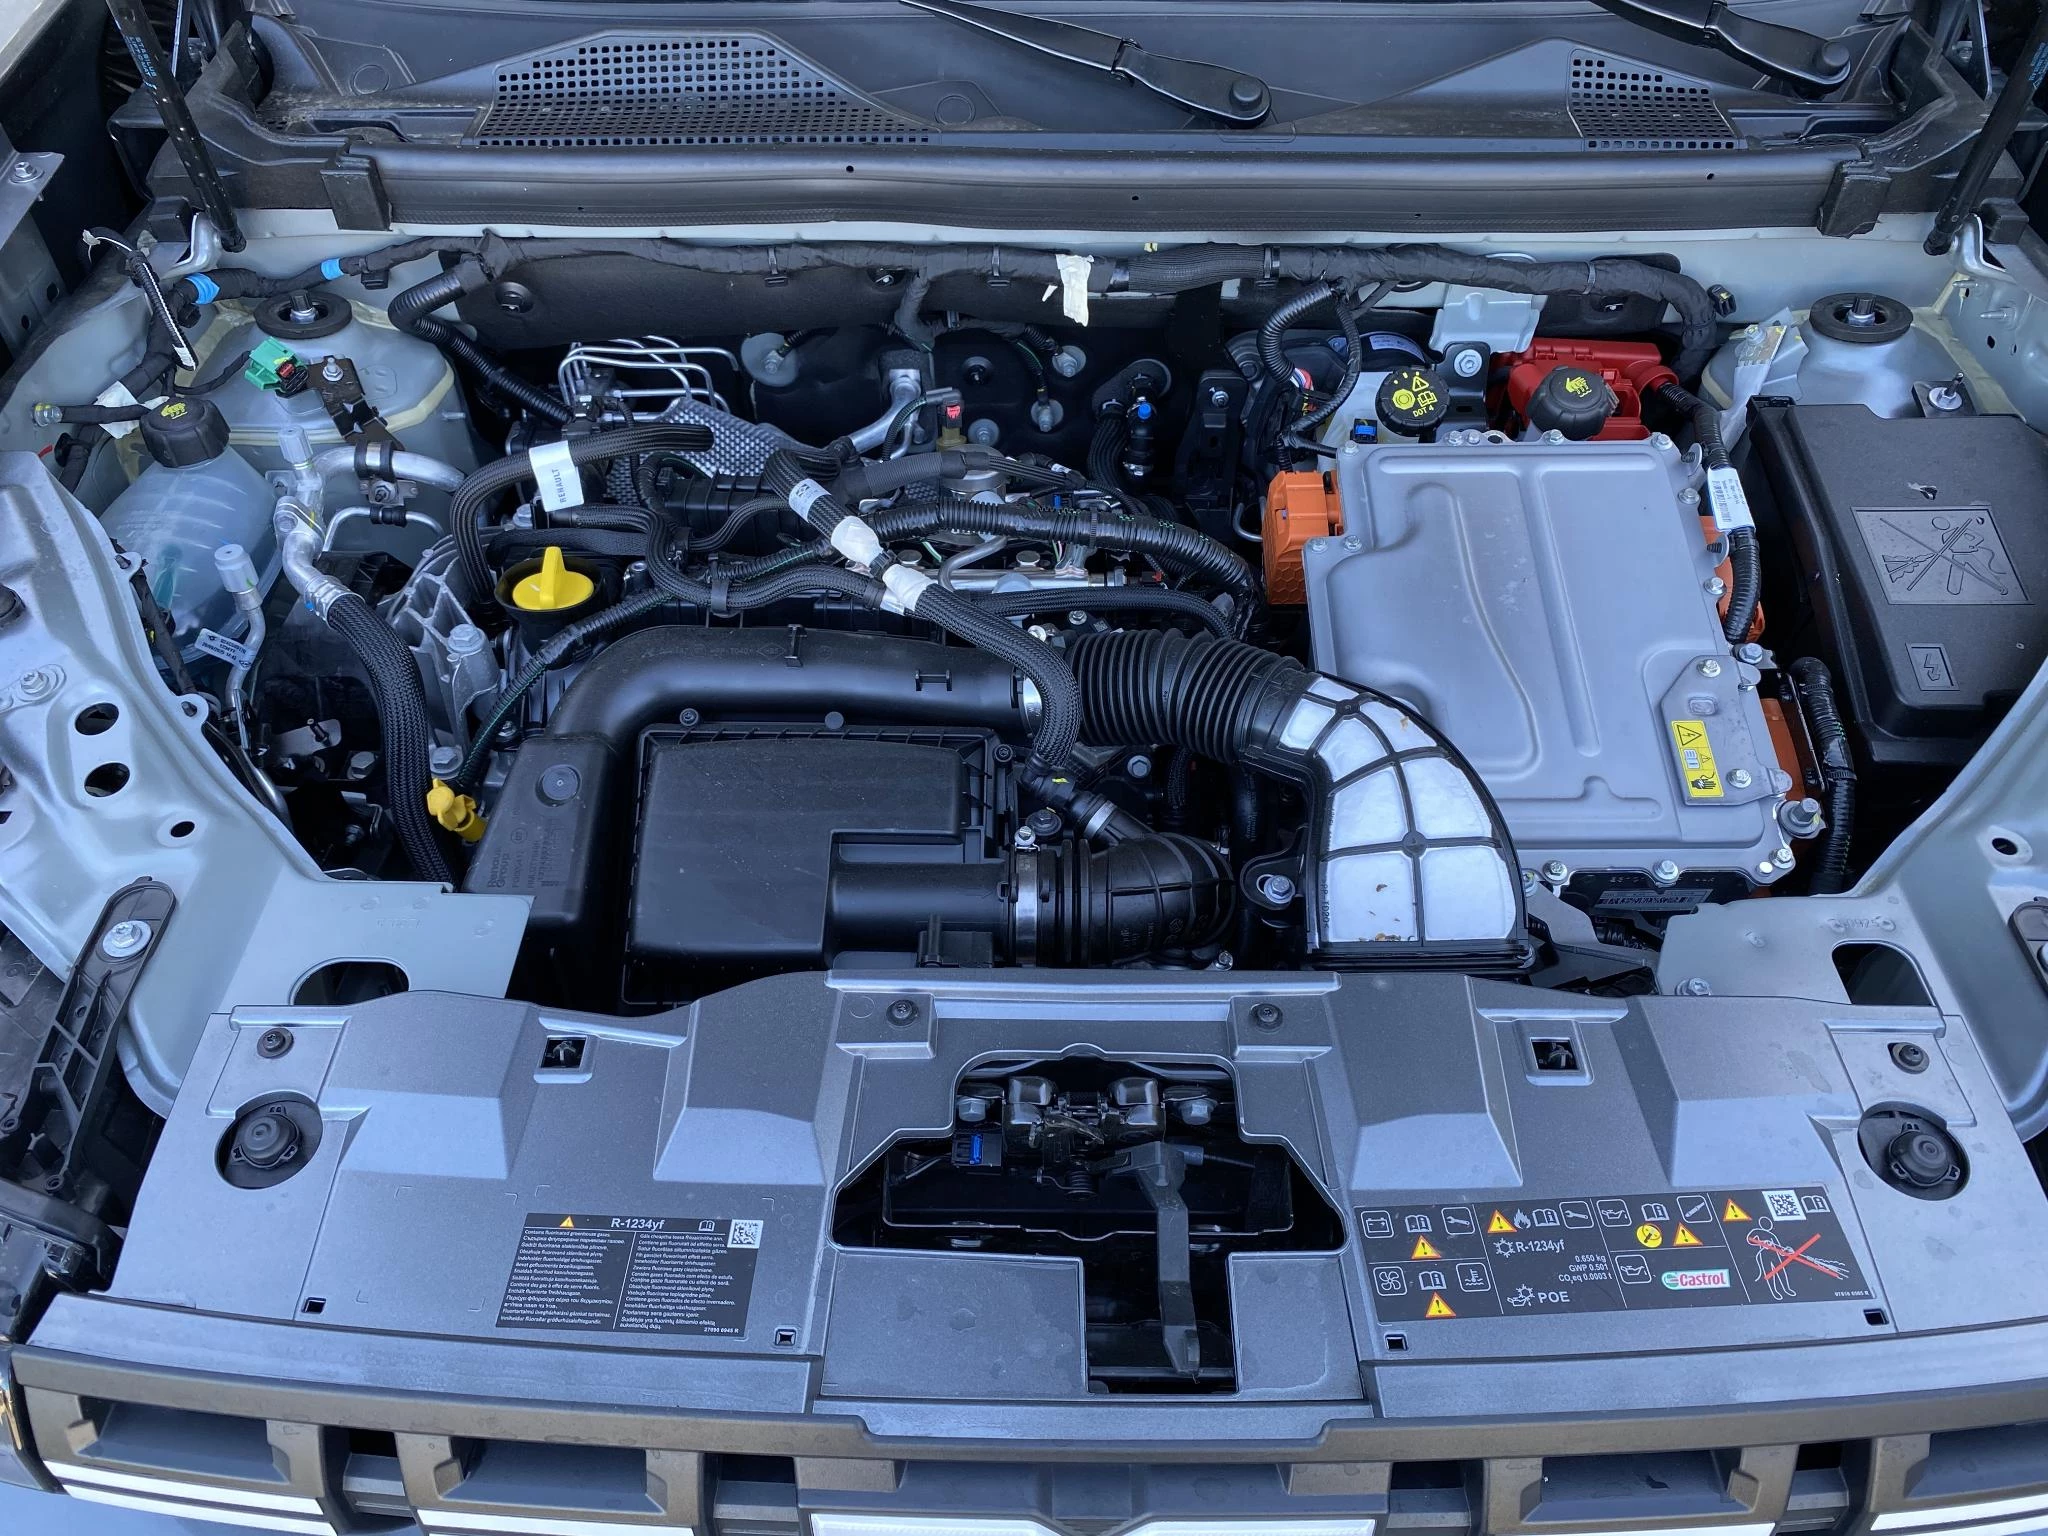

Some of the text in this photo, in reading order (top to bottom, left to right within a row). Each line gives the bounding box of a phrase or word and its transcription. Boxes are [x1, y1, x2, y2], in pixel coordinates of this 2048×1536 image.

[1412, 407, 1427, 417] DOT
[610, 1218, 666, 1231] R-1234yf
[1516, 1239, 1565, 1254] R-1234yf
[1596, 1254, 1606, 1263] kg
[1568, 1263, 1608, 1272] GWP 0.501
[1583, 1272, 1608, 1280] 0.0003
[1679, 1272, 1725, 1287] Castrol
[1538, 1291, 1570, 1304] POE
